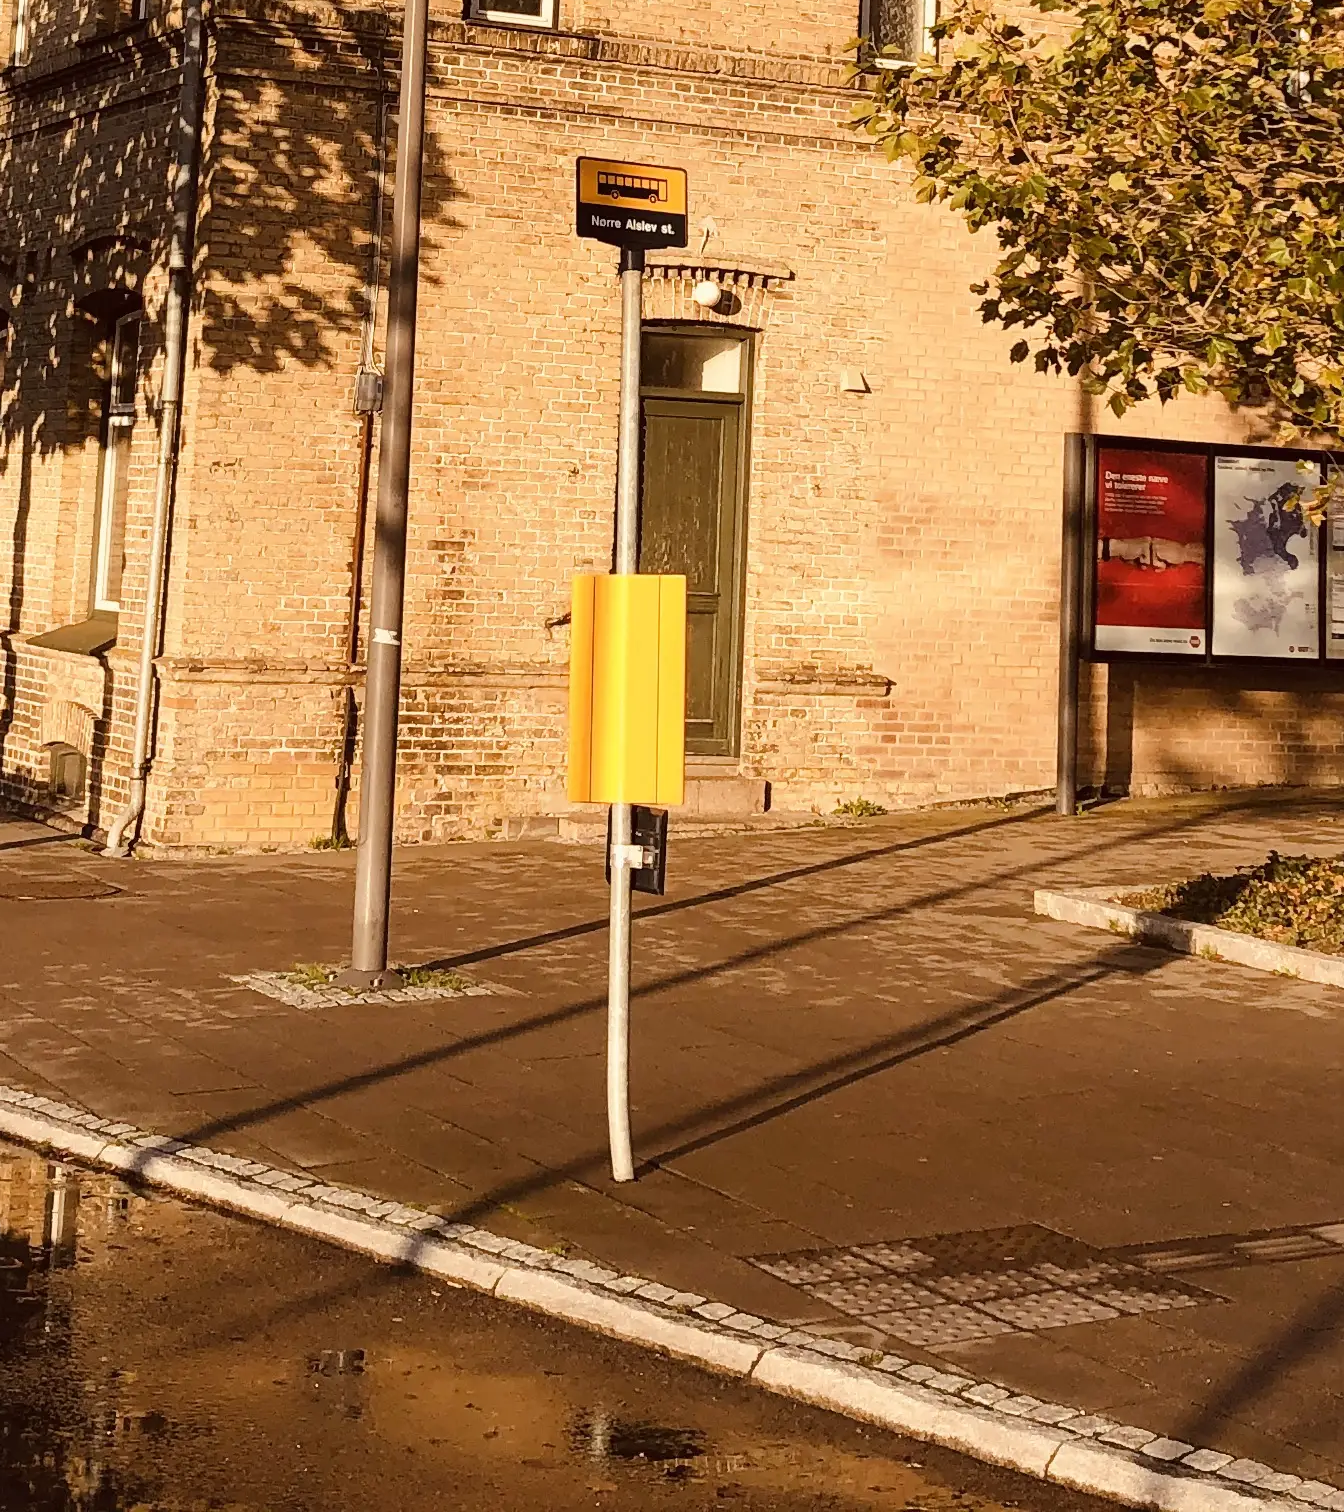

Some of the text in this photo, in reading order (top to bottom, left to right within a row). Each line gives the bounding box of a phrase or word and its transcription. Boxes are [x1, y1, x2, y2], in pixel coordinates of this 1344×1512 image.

[591, 215, 675, 235] Nørre Alslev st.
